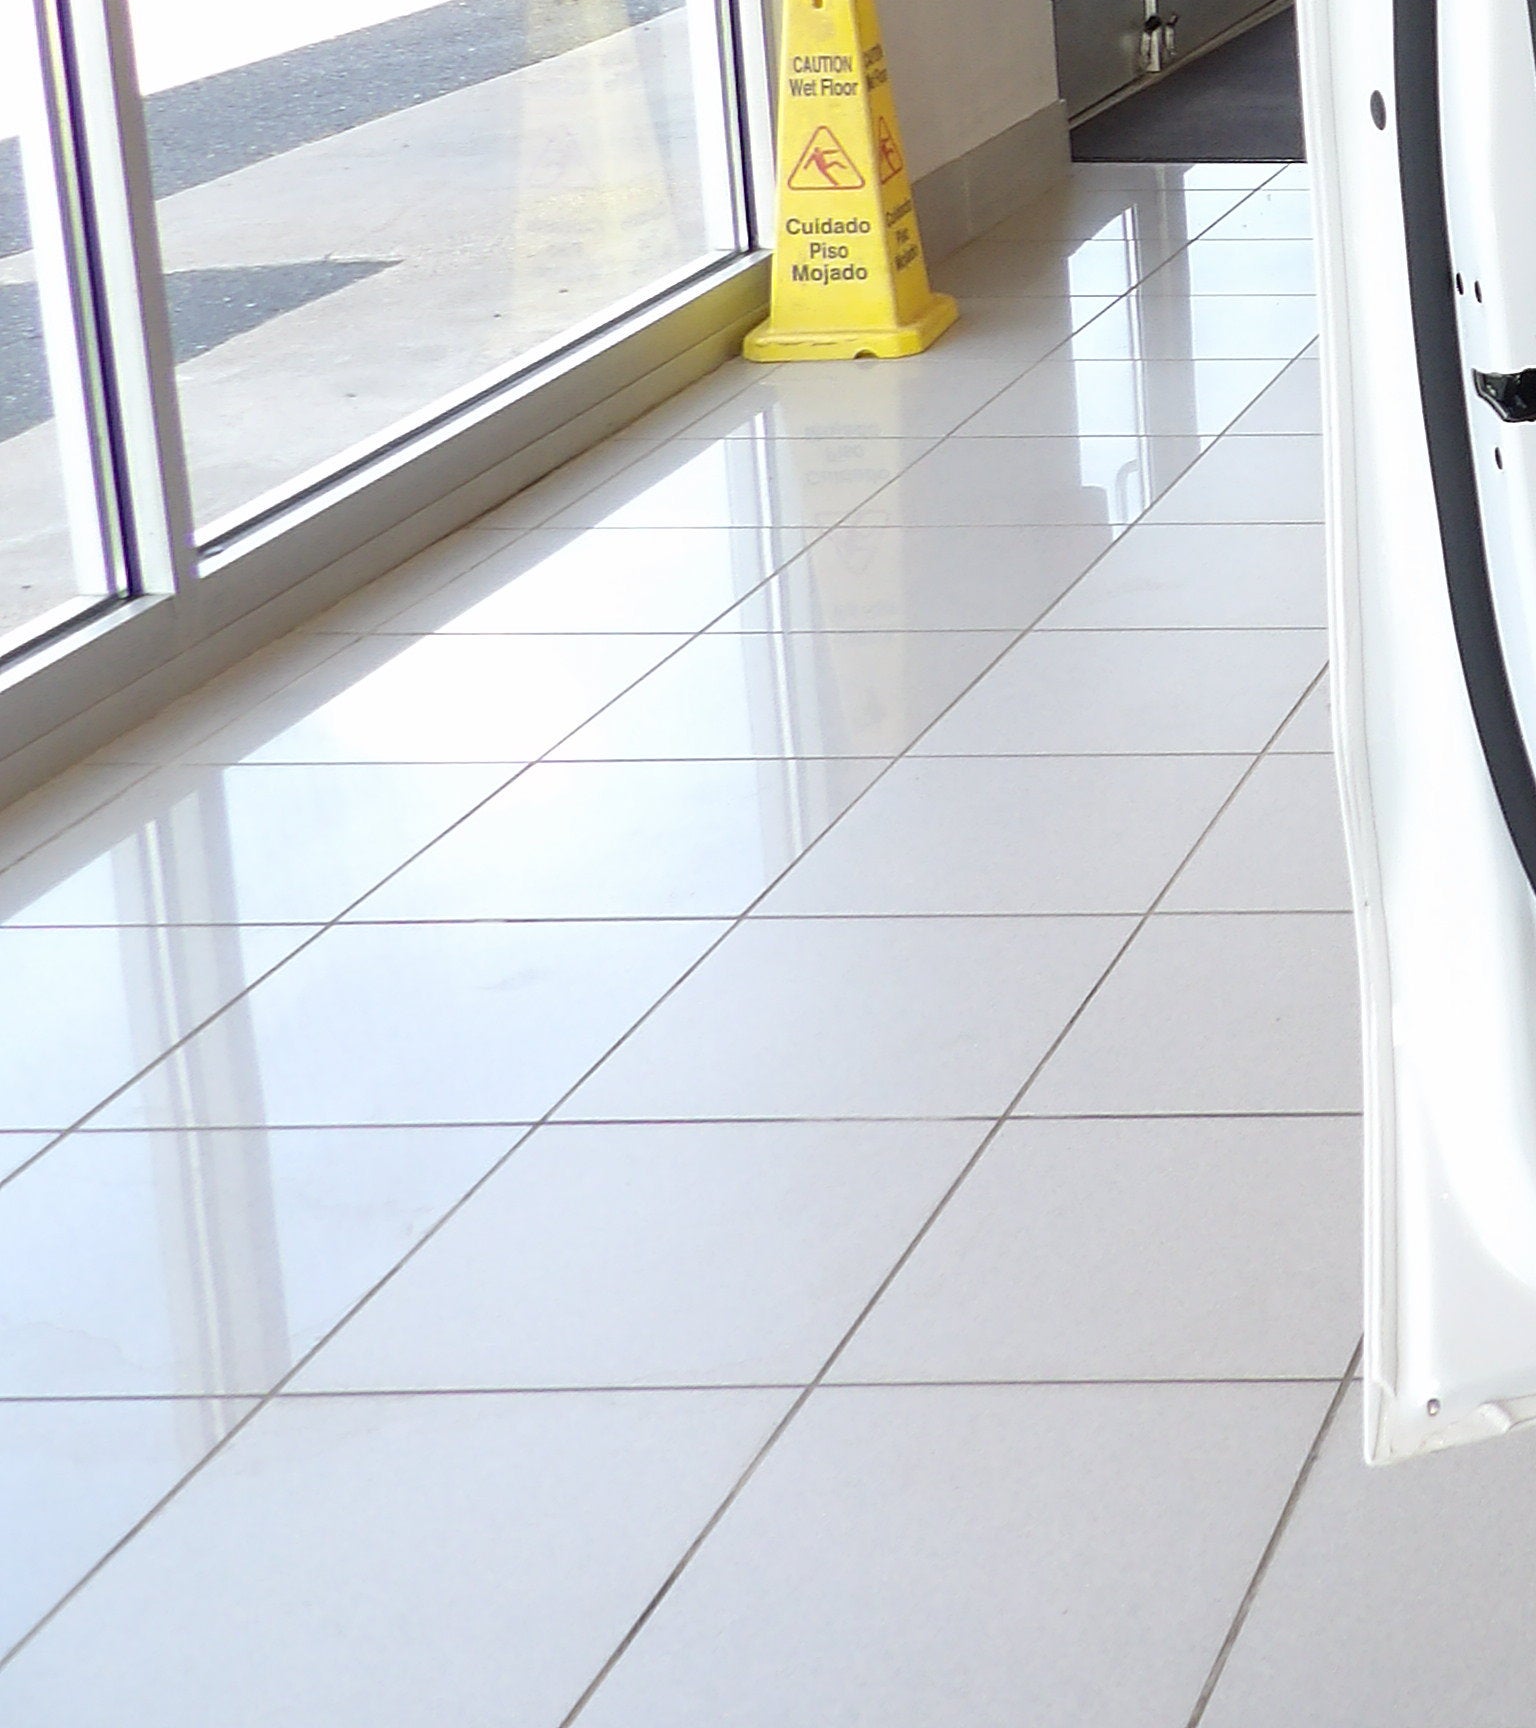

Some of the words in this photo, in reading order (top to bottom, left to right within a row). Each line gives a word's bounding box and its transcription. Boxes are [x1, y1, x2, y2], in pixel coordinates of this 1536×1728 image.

[793, 55, 853, 73] CAUTION
[789, 78, 817, 96] Wet
[821, 78, 859, 96] Floor
[785, 217, 871, 235] Cuidado
[810, 241, 849, 259] Piso
[792, 263, 868, 286] Mojado
